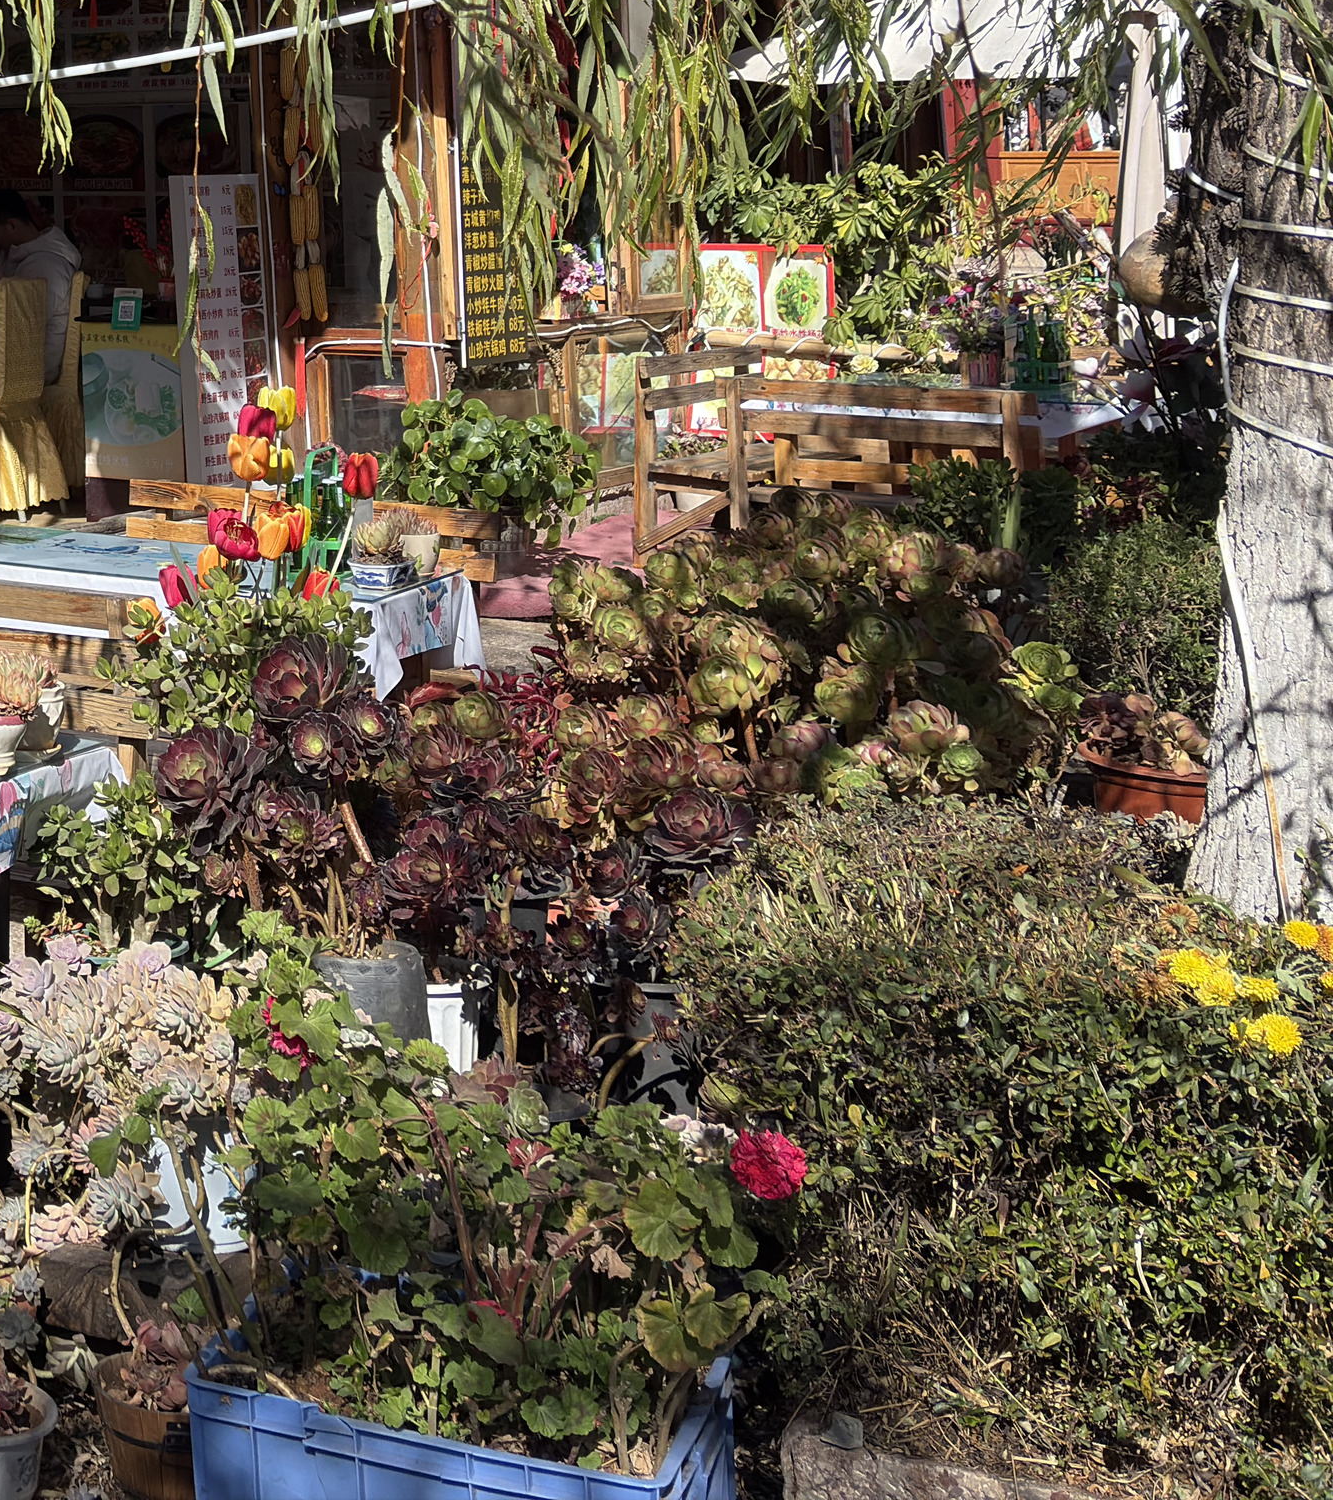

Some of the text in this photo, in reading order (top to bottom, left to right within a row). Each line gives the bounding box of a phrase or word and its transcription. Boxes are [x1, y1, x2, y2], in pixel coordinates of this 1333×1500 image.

[466, 273, 504, 294] 青椒炒火腿
[508, 315, 525, 332] 68元
[468, 337, 526, 359] 山珍汽锅鸡 68元
